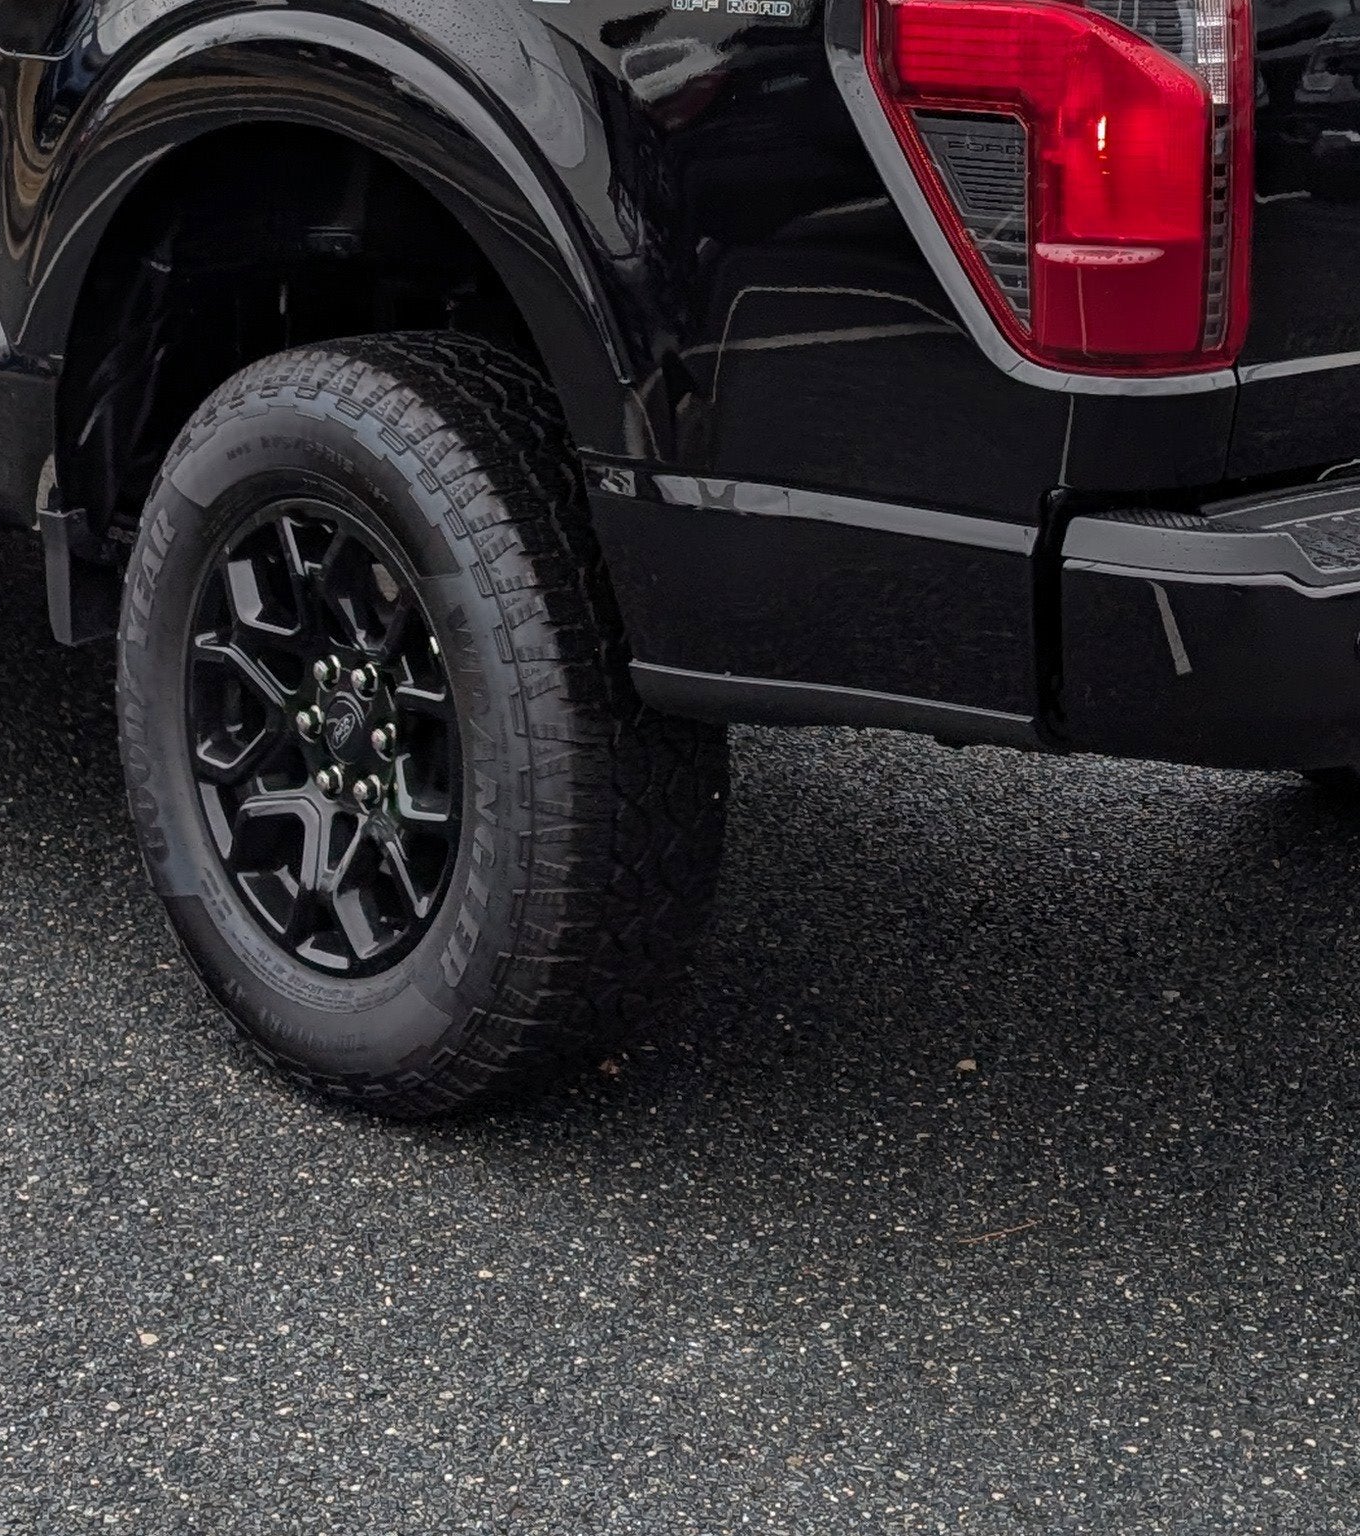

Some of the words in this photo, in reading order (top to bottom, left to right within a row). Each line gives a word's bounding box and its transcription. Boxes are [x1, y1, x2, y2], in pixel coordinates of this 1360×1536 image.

[727, 0, 792, 16] ROAD
[948, 141, 1025, 155] FORD
[119, 506, 177, 864] GOODYEAR
[439, 602, 501, 988] WRANGLER
